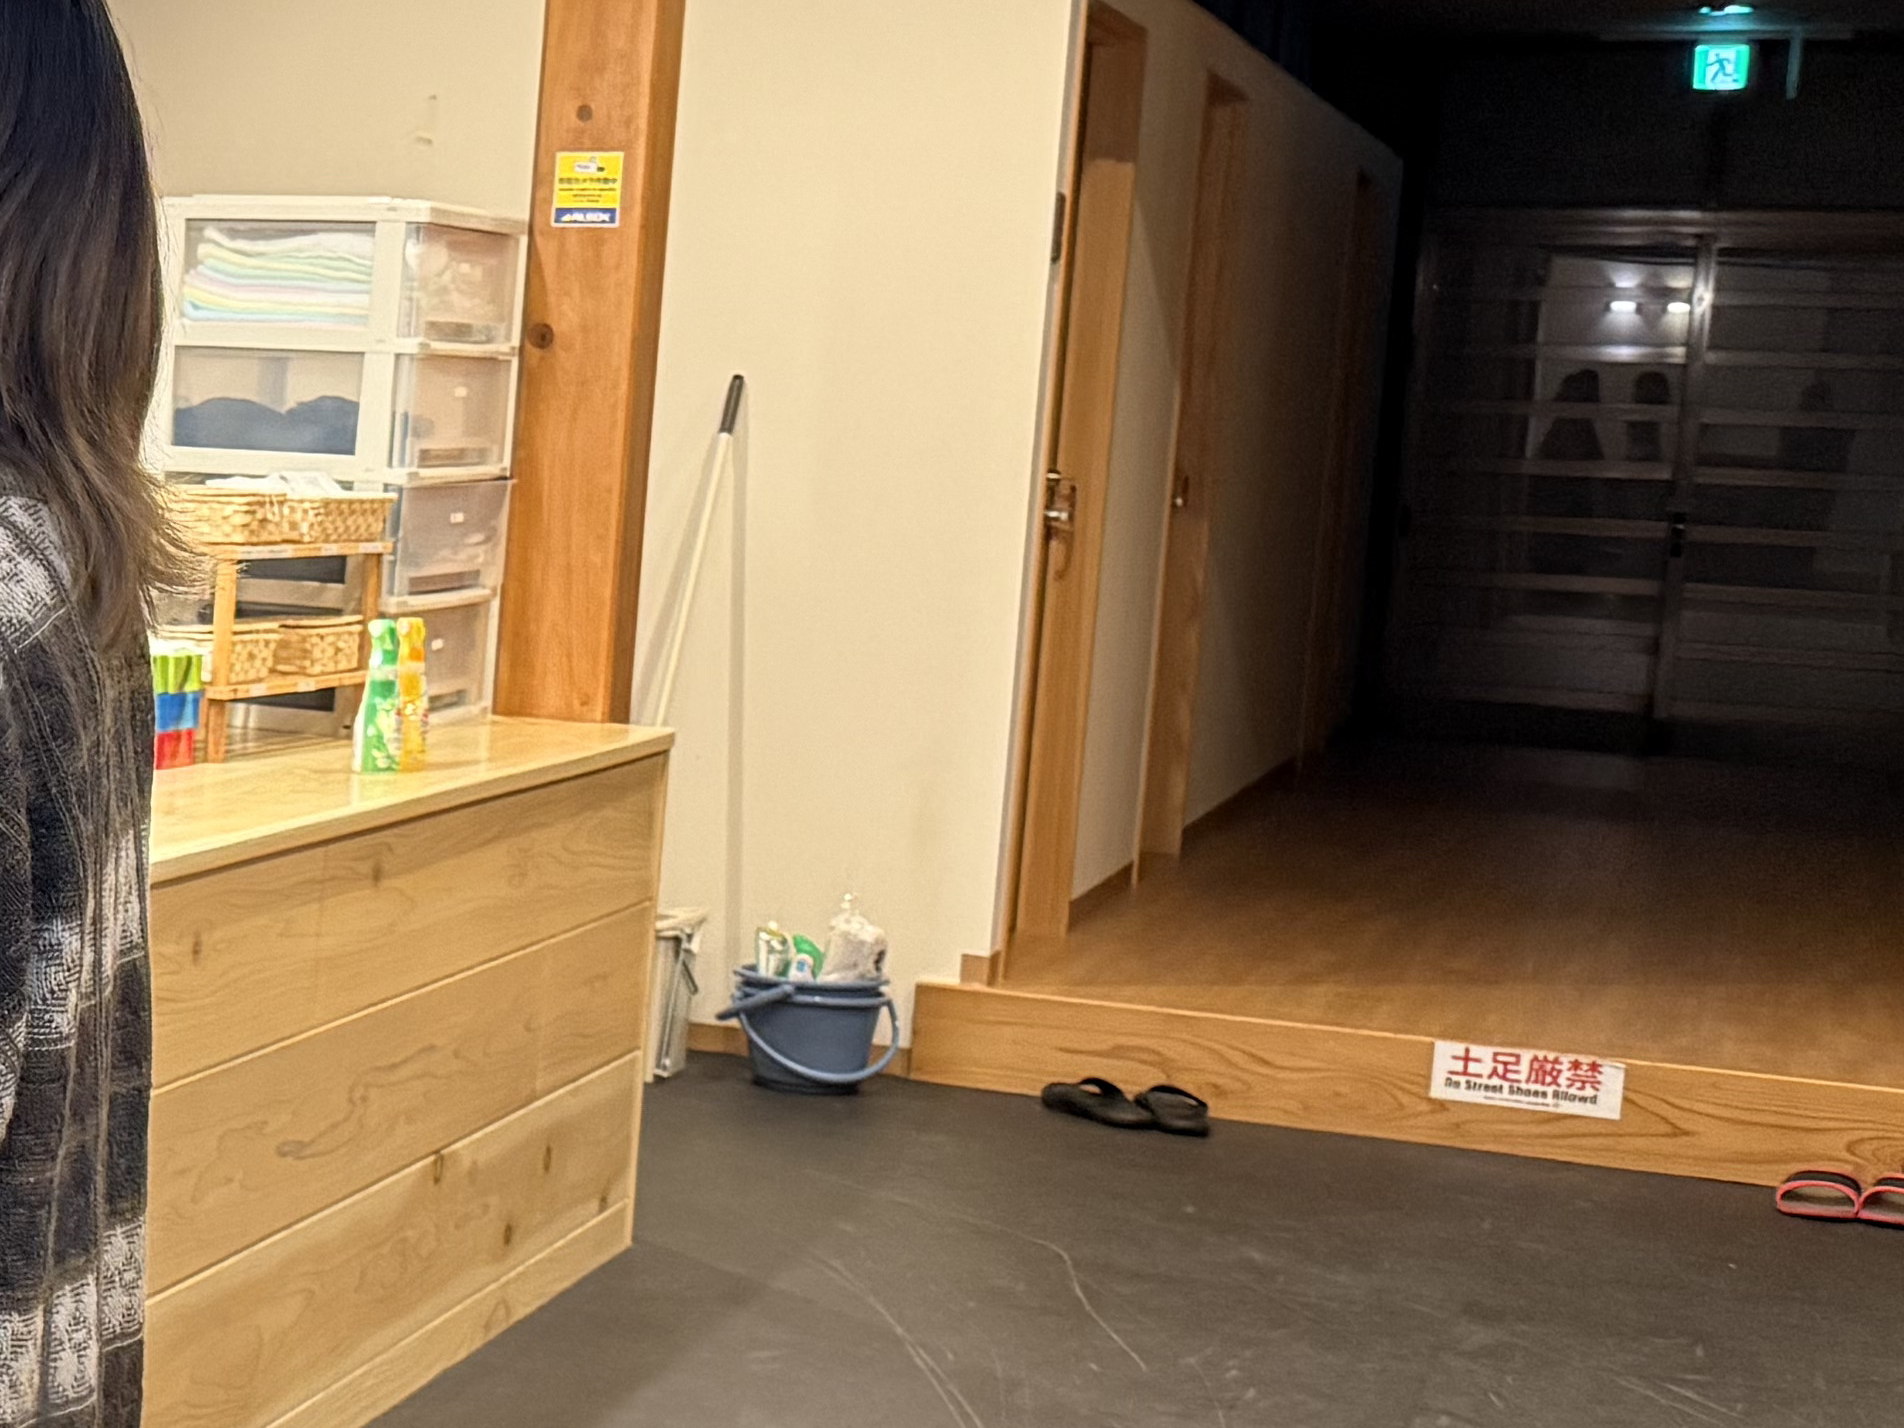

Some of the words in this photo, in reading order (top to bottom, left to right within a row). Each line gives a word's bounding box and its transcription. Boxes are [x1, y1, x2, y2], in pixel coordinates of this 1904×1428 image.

[1447, 1046, 1604, 1093] 土足厳禁
[1464, 1080, 1505, 1093] Street
[1508, 1084, 1549, 1099] Shoes
